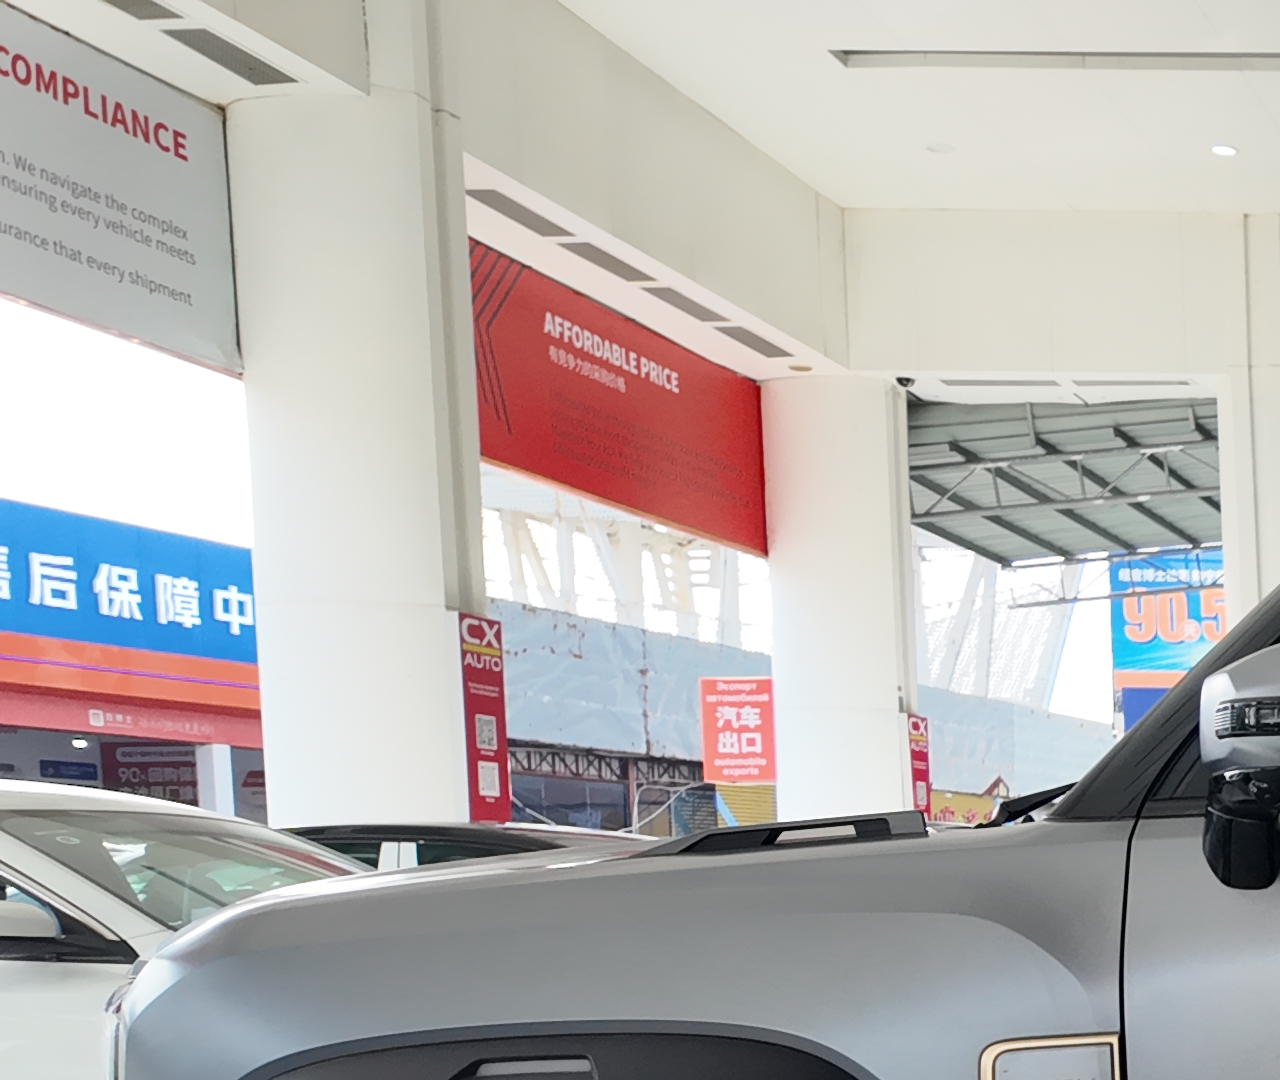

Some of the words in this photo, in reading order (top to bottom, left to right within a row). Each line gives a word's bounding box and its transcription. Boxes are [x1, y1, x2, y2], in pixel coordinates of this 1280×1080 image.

[12, 152, 37, 177] We
[40, 167, 101, 202] navigate
[104, 193, 128, 217] the
[130, 205, 189, 242] complex
[61, 200, 101, 229] every
[103, 214, 153, 248] vehicle
[155, 237, 196, 266] meets
[52, 240, 84, 266] that
[86, 253, 125, 283] every
[128, 268, 193, 307] shipment
[543, 311, 639, 375] AFFORDABLE
[639, 355, 680, 394] PRICE
[0, 545, 254, 636] 后保障中
[461, 616, 500, 649] CX
[464, 652, 502, 672] AUTO
[714, 705, 762, 729] 汽车
[908, 717, 927, 736] CX
[717, 730, 763, 754] 出口
